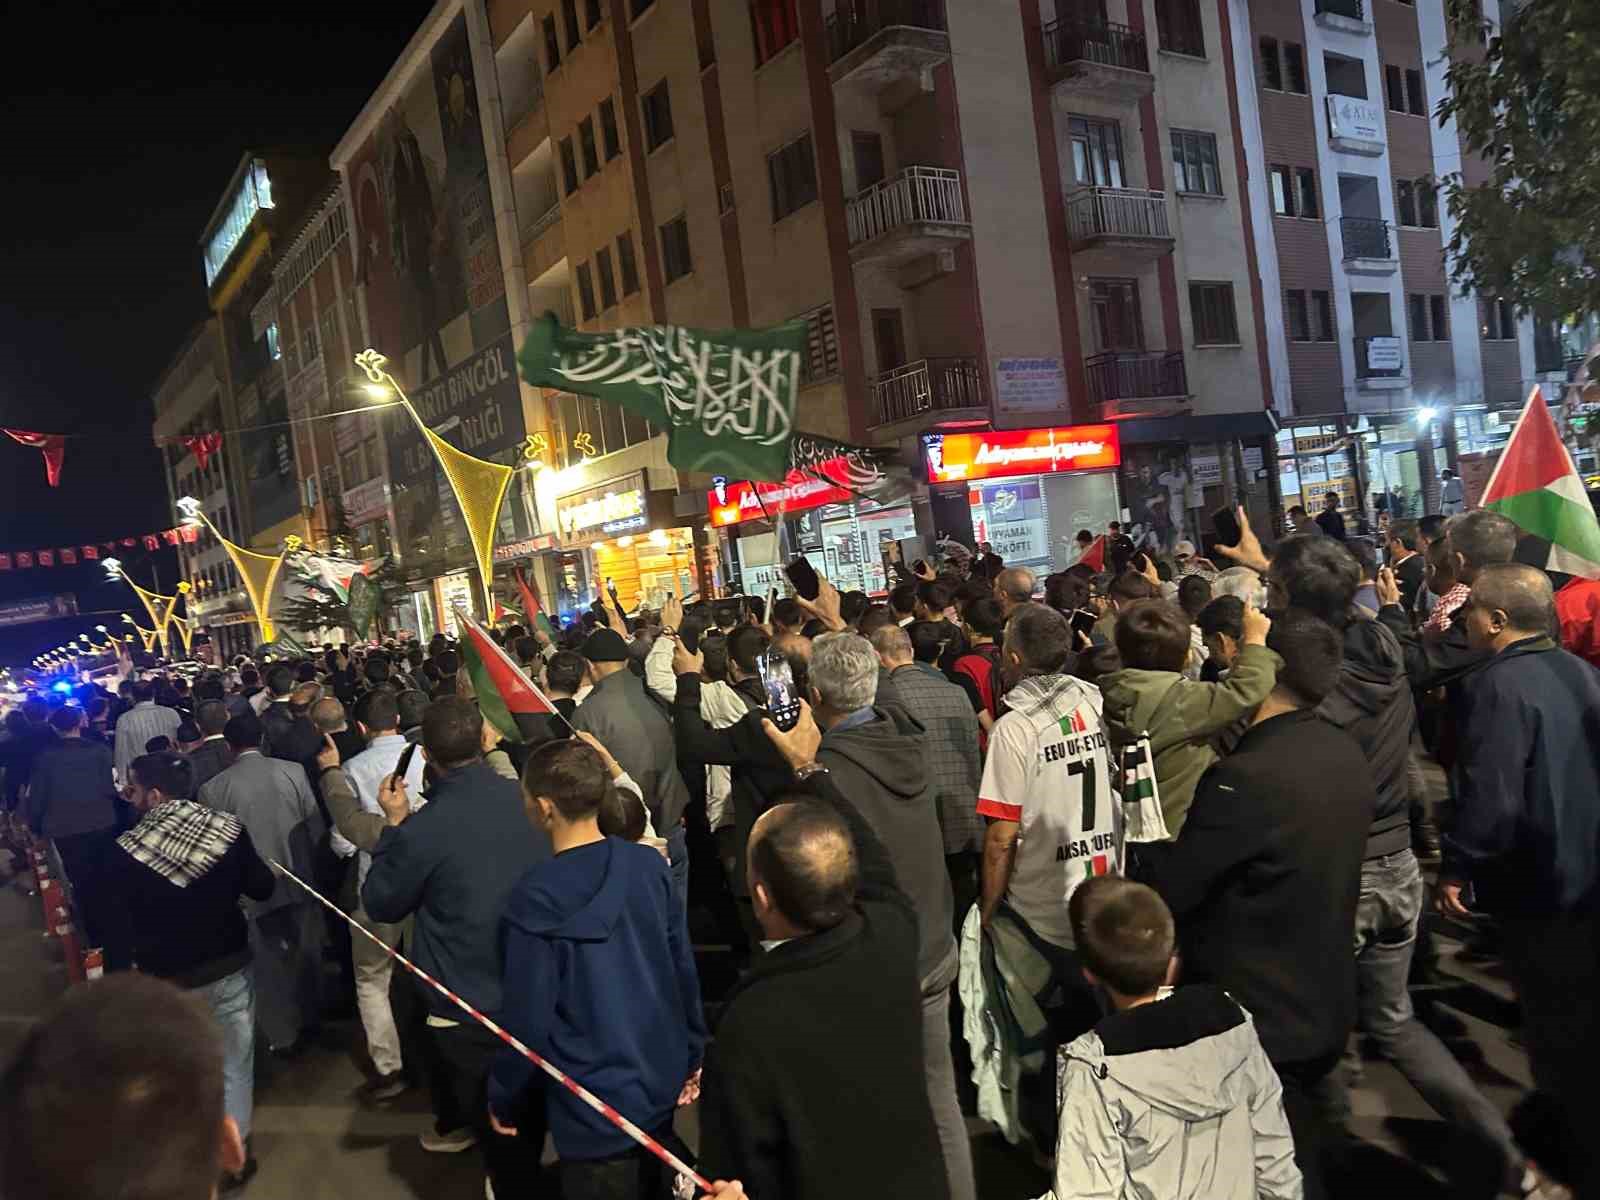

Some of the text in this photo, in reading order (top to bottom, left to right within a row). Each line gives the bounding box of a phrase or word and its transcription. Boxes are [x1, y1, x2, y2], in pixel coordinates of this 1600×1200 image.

[449, 346, 509, 406] BİNGÖL
[1066, 757, 1096, 832] 7
[1056, 840, 1089, 862] AKSA
